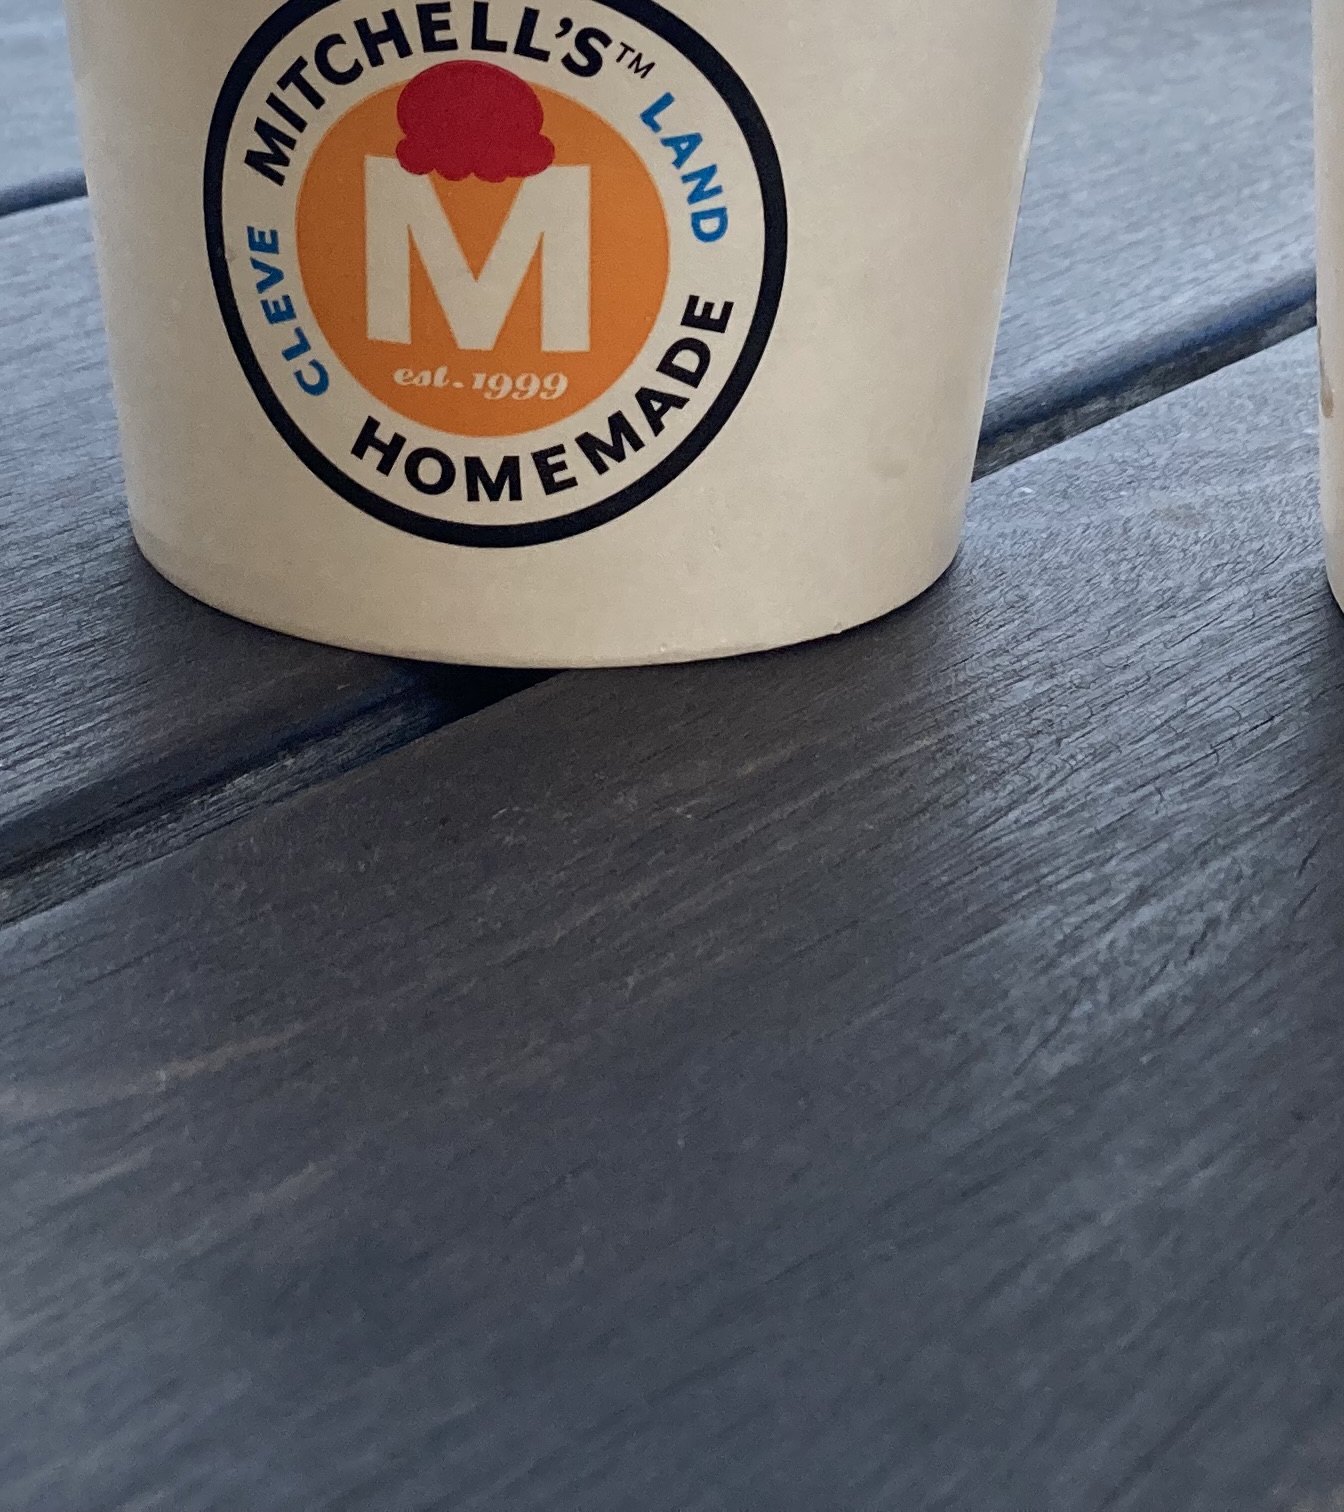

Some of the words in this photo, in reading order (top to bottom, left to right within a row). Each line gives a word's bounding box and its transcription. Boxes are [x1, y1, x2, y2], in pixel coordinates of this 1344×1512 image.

[243, 0, 613, 187] MITCHELL'S
[246, 225, 330, 398] CLEVE
[639, 91, 729, 244] LAND
[364, 155, 591, 353] M
[350, 294, 734, 503] HOMEMADE
